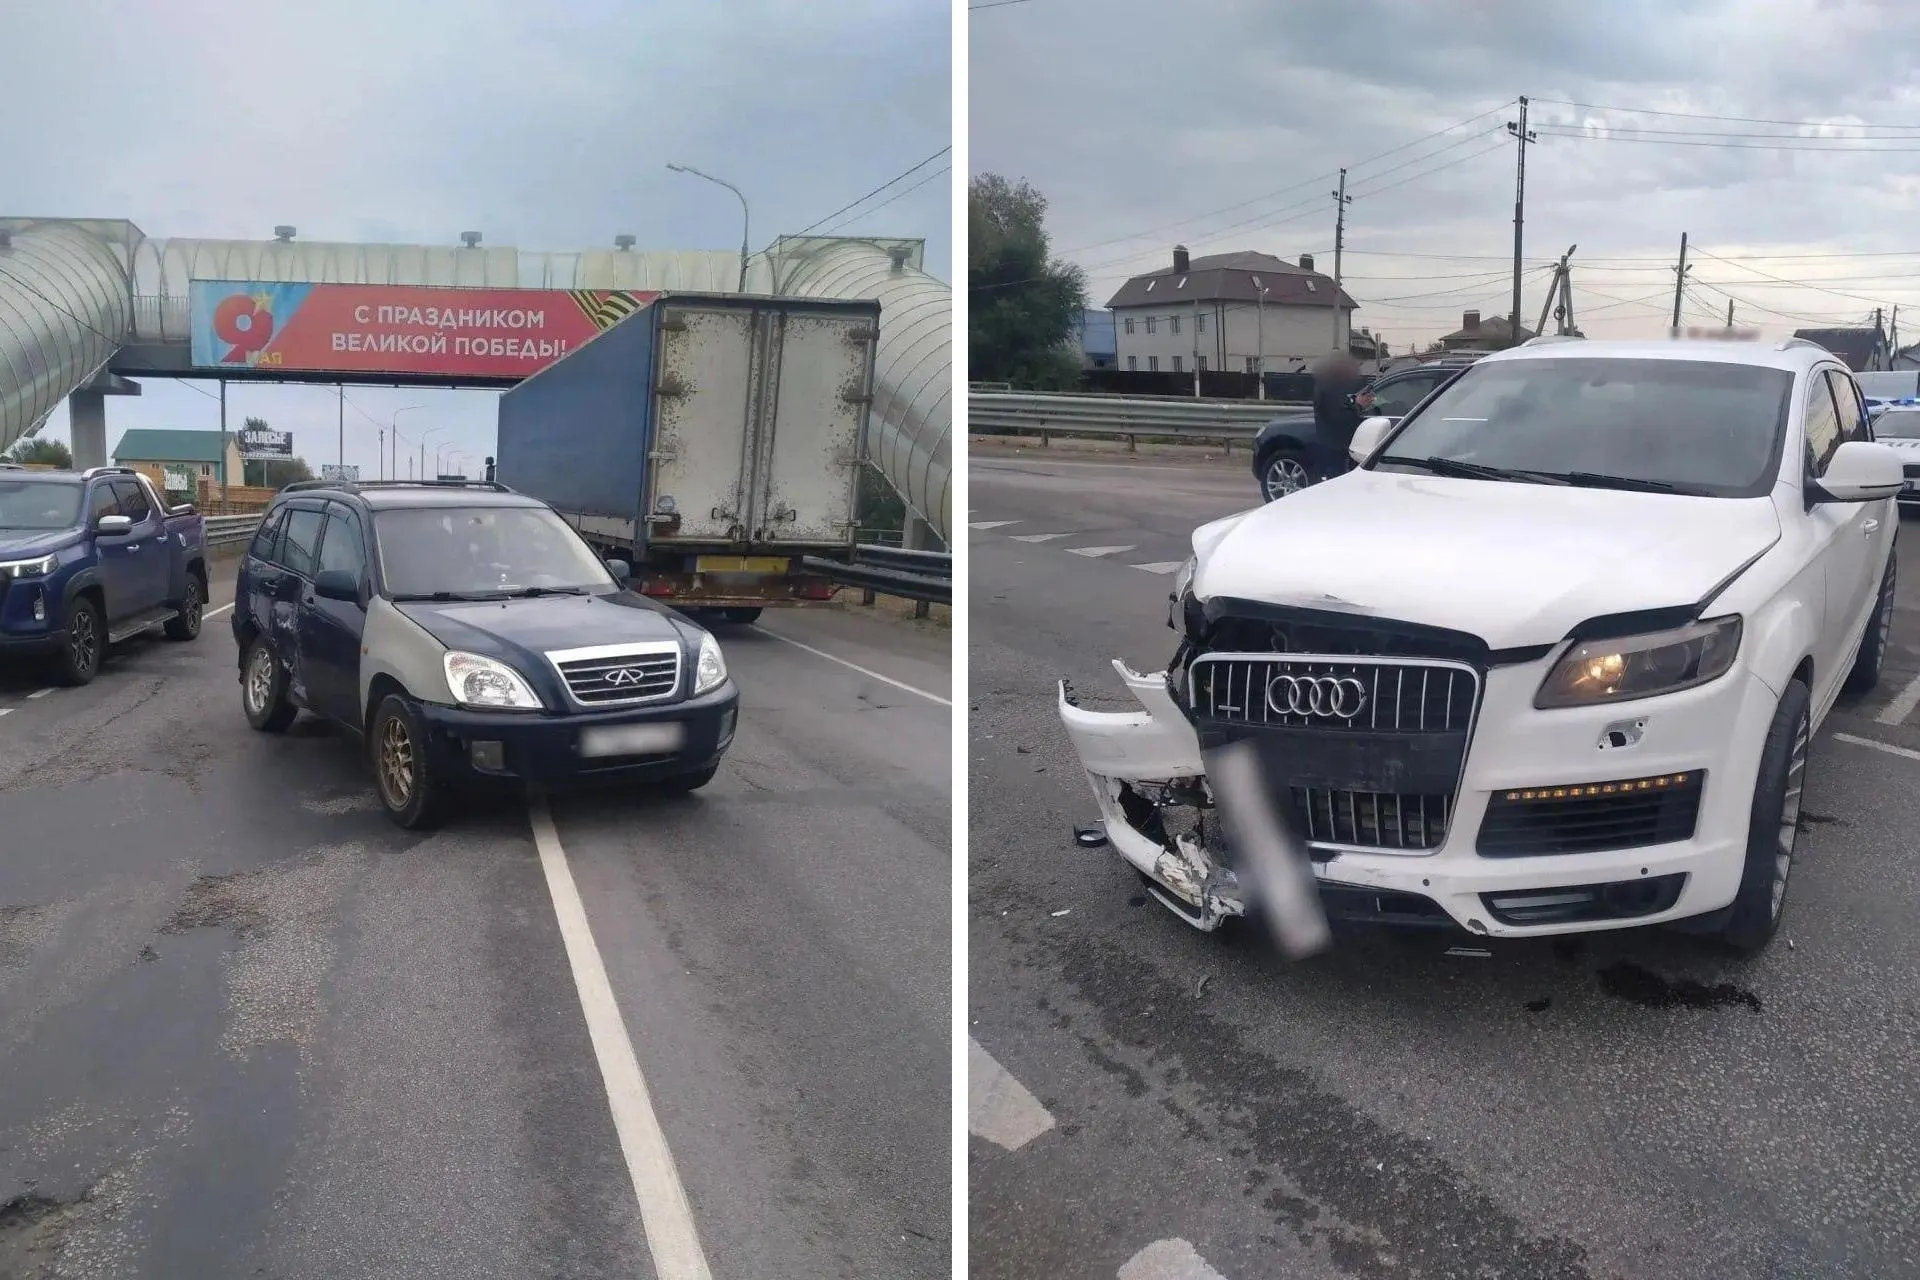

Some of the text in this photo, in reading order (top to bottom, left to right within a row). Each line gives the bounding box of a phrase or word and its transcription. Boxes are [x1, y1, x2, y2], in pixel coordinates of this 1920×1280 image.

[213, 294, 274, 363] 9
[354, 305, 545, 329] С ПРАЗДНИКОМ
[332, 331, 567, 360] ВЕЛИКОЙ ПОБЕДЫ!
